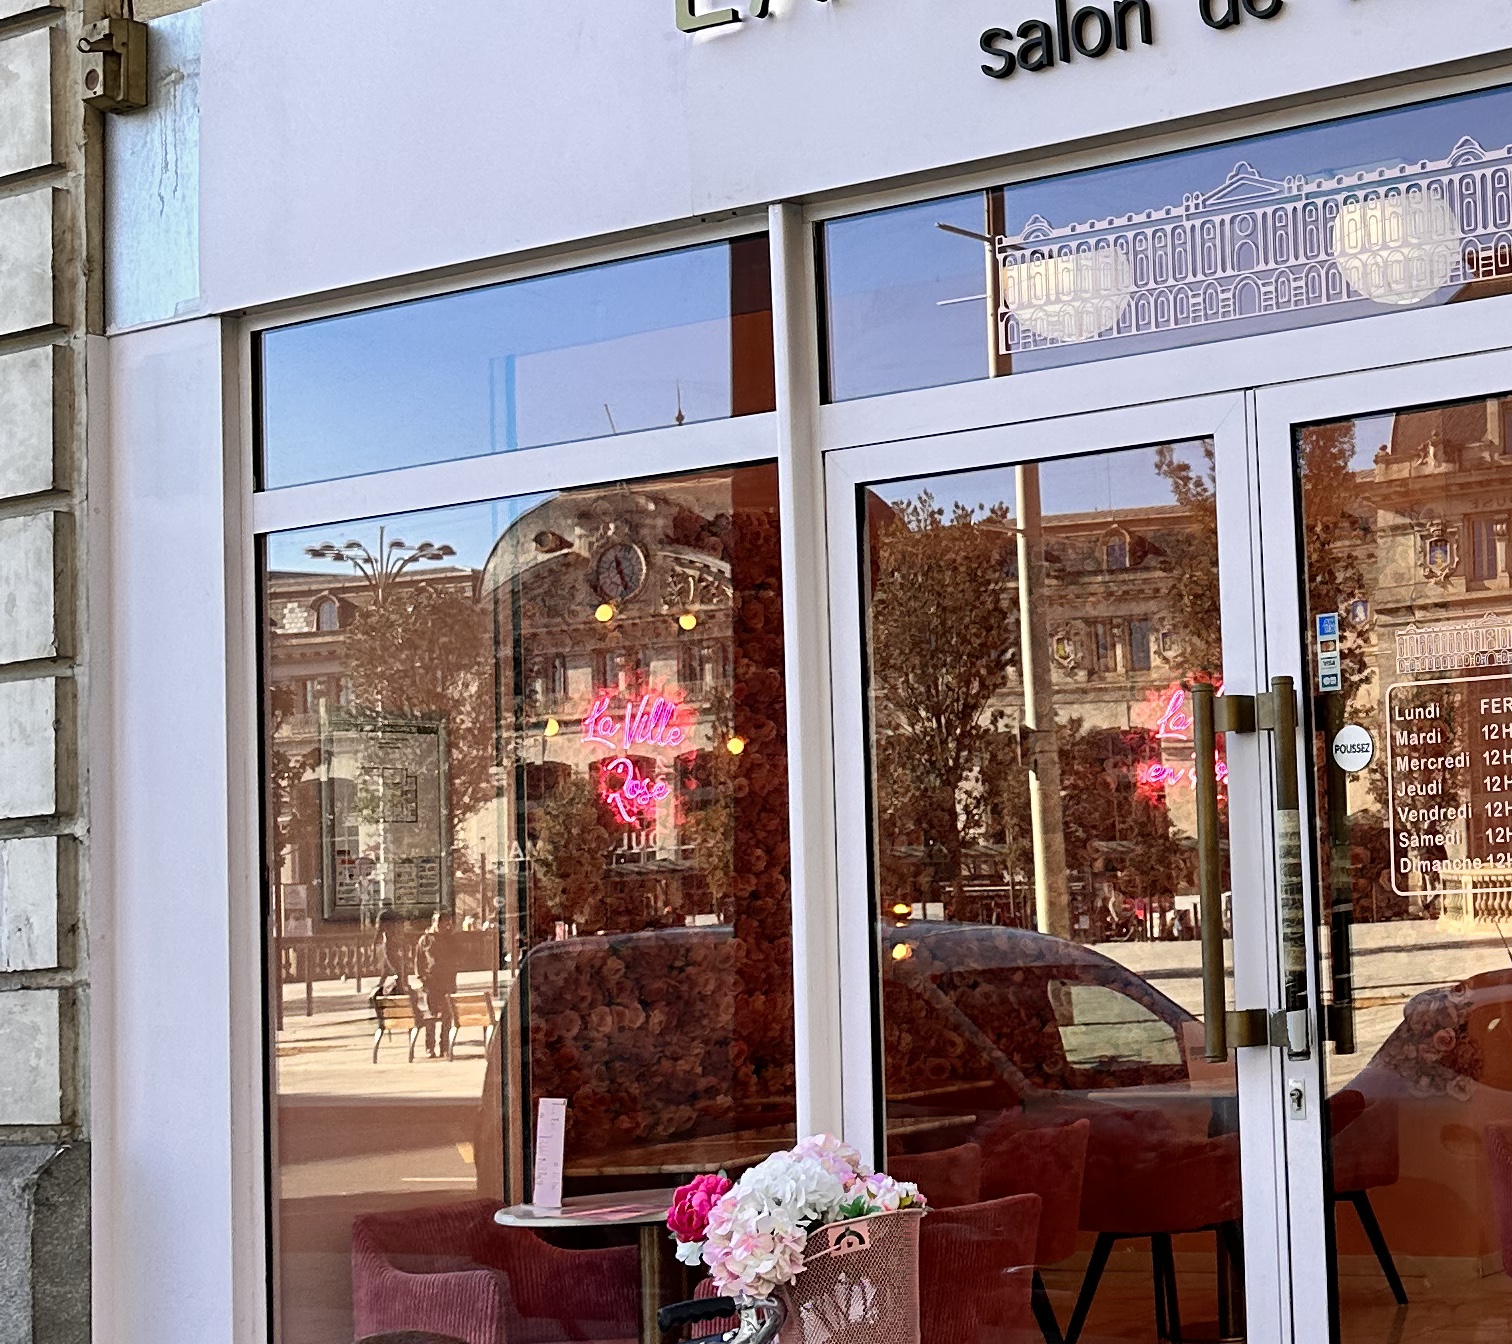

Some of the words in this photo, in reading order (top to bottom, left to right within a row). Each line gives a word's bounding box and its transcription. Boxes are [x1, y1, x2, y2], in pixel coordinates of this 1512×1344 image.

[1395, 702, 1440, 721] Lundi
[581, 697, 621, 749] La
[622, 694, 686, 750] Ville
[1395, 728, 1442, 746] Mardi
[1334, 743, 1370, 754] POUSSEZ
[1396, 751, 1470, 771] Mercredi
[606, 757, 673, 822] Rose
[1397, 779, 1442, 797] Jeudi
[1397, 803, 1472, 822] Vendredi
[1399, 830, 1462, 848] Samedi
[1400, 857, 1482, 874] Dimanche
